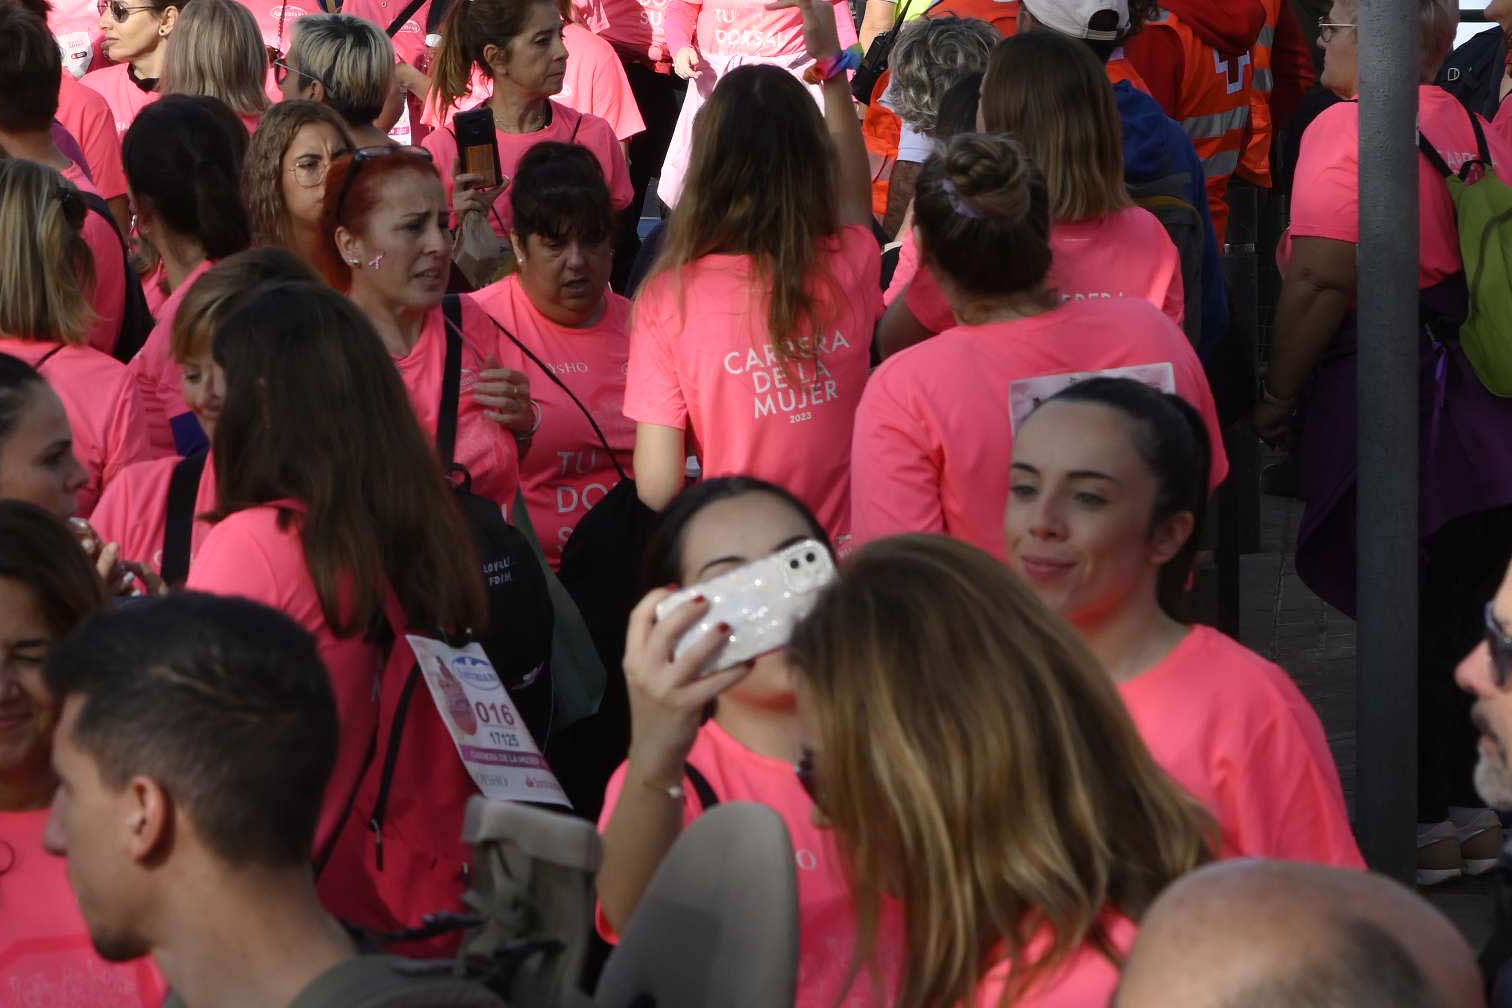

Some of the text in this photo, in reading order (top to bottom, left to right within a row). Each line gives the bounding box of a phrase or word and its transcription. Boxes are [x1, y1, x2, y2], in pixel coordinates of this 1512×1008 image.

[548, 362, 588, 374] YSHO
[751, 359, 831, 395] DE LA
[753, 379, 839, 420] MUJER
[789, 411, 813, 424] 2023
[557, 450, 597, 475] TU
[475, 701, 515, 726] 016
[489, 731, 520, 747] 17125
